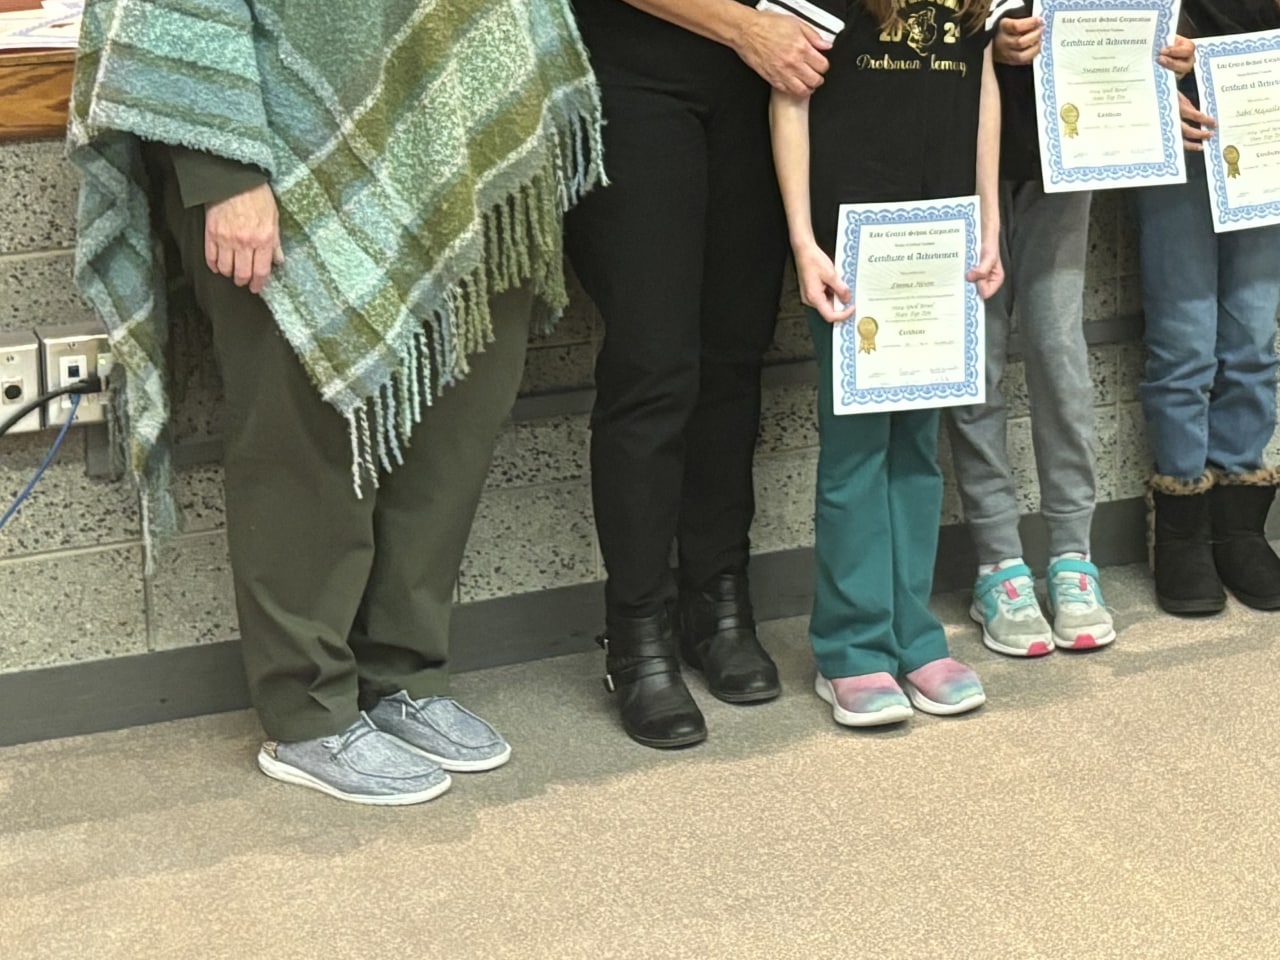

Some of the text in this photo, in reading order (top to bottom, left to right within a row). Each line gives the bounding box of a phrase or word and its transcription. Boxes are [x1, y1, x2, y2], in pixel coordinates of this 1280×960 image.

[1060, 38, 1147, 48] Certificate of Achievement
[867, 251, 959, 263] Certificate of Achievement
